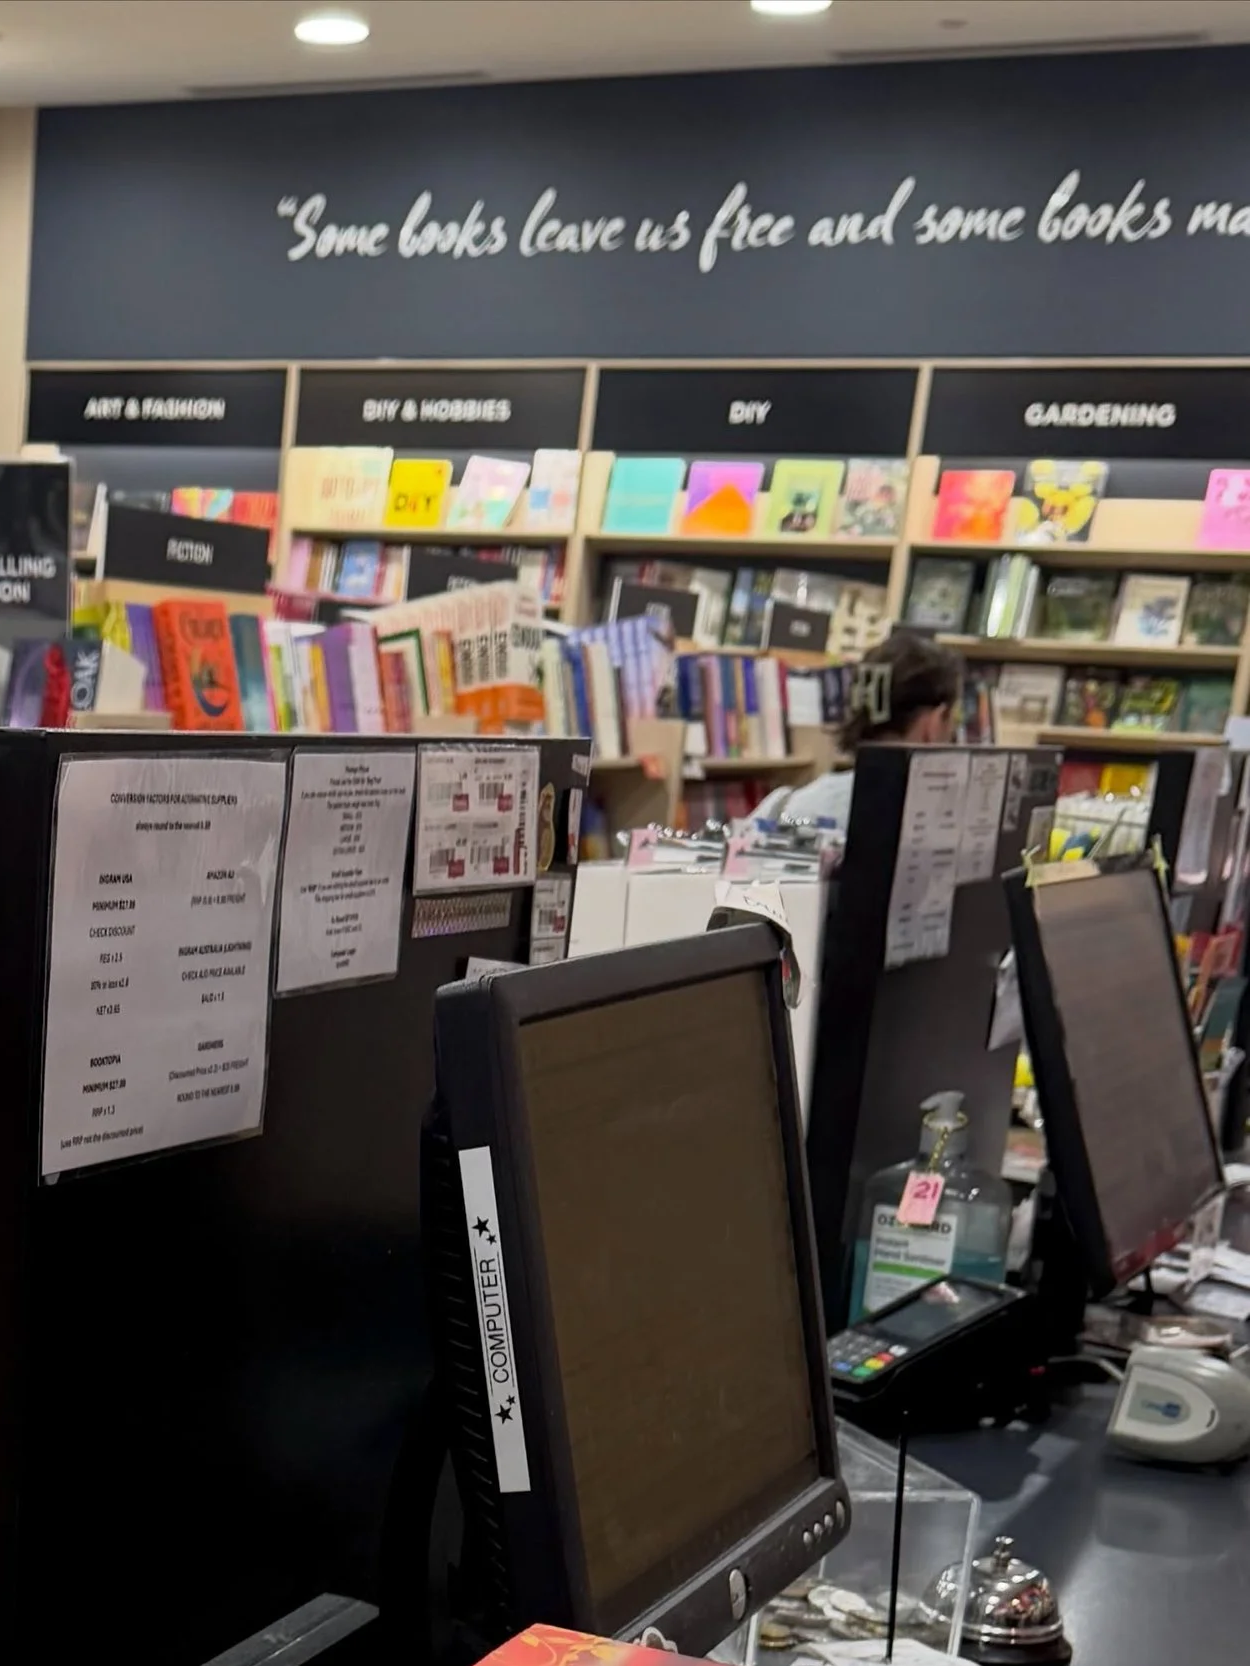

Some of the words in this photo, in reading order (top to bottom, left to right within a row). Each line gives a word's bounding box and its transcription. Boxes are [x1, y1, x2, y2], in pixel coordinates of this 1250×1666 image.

[399, 190, 507, 259] books
[520, 186, 626, 257] leave
[635, 209, 691, 252] us
[699, 181, 794, 273] free
[808, 175, 916, 247] and
[914, 204, 1026, 246] some
[1038, 169, 1172, 245] books
[84, 397, 123, 420] ART
[124, 398, 140, 420] &
[143, 397, 226, 420] FASHION
[362, 399, 399, 422] DIY
[400, 399, 417, 422] &
[419, 399, 511, 422] HOBBIES
[728, 401, 770, 426] DIY
[1025, 403, 1176, 428] GARDENING
[167, 539, 213, 565] FICTION
[912, 1180, 940, 1201] 21
[479, 1256, 511, 1385] COMPUTER
